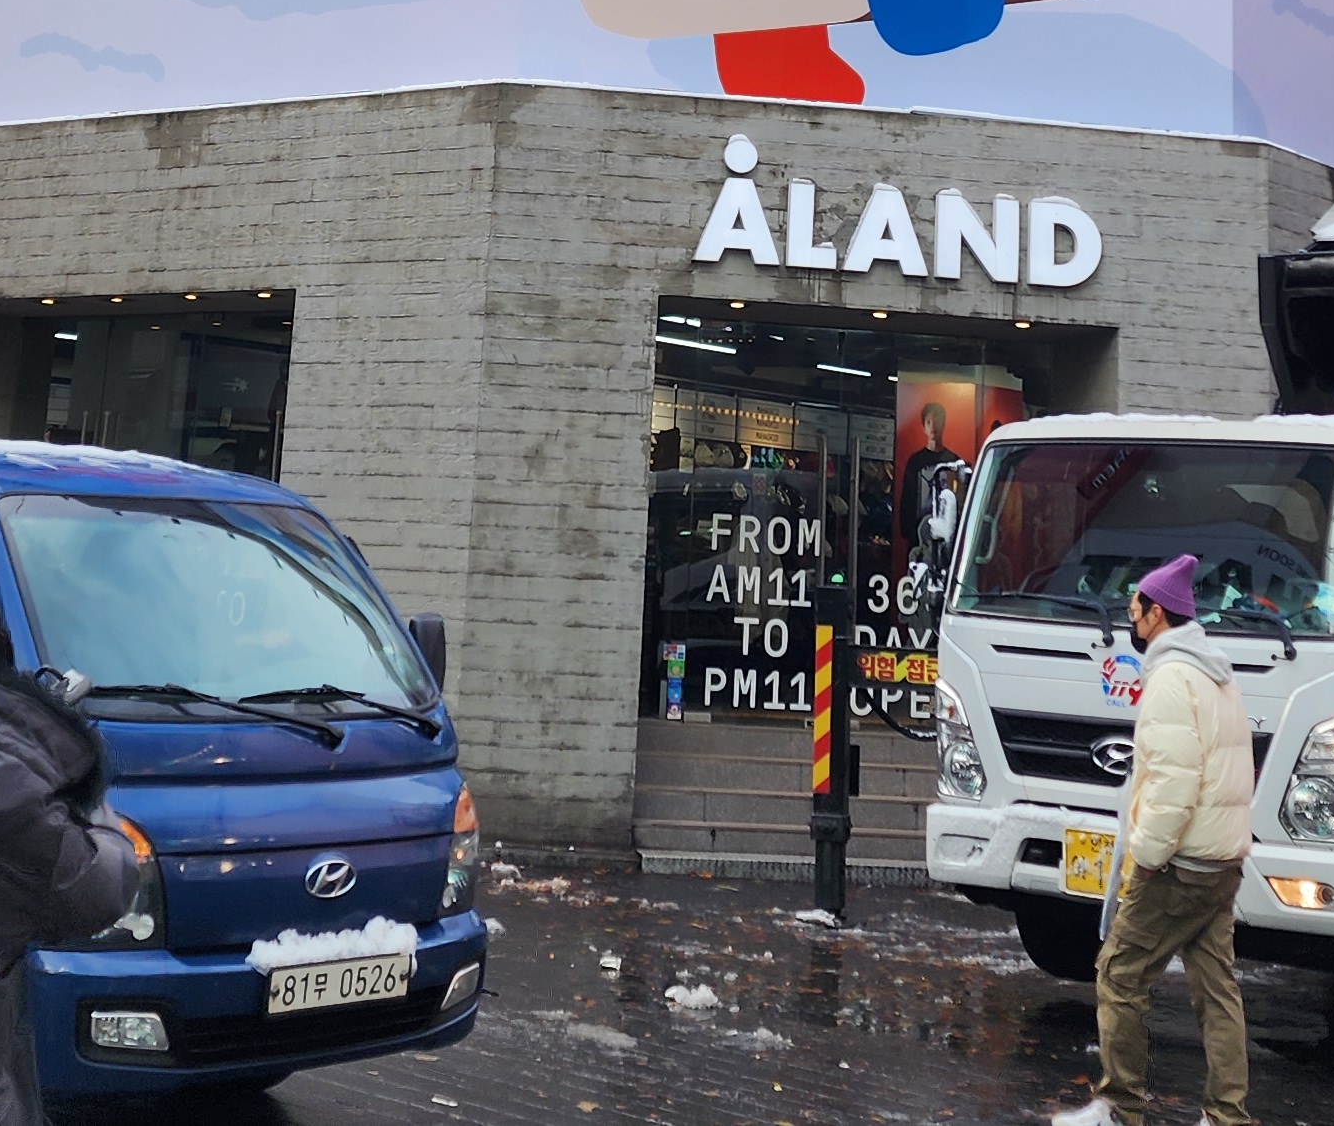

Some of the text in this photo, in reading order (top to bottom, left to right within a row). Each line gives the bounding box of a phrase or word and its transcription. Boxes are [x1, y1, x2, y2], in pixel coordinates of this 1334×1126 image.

[711, 512, 822, 556] FROM
[705, 564, 812, 608] AM11
[867, 574, 921, 615] 36
[733, 617, 789, 658] TO
[854, 625, 932, 649] DAY
[704, 667, 812, 712] PM11
[849, 687, 931, 719] OPE
[281, 962, 397, 1006] 81무 0526
